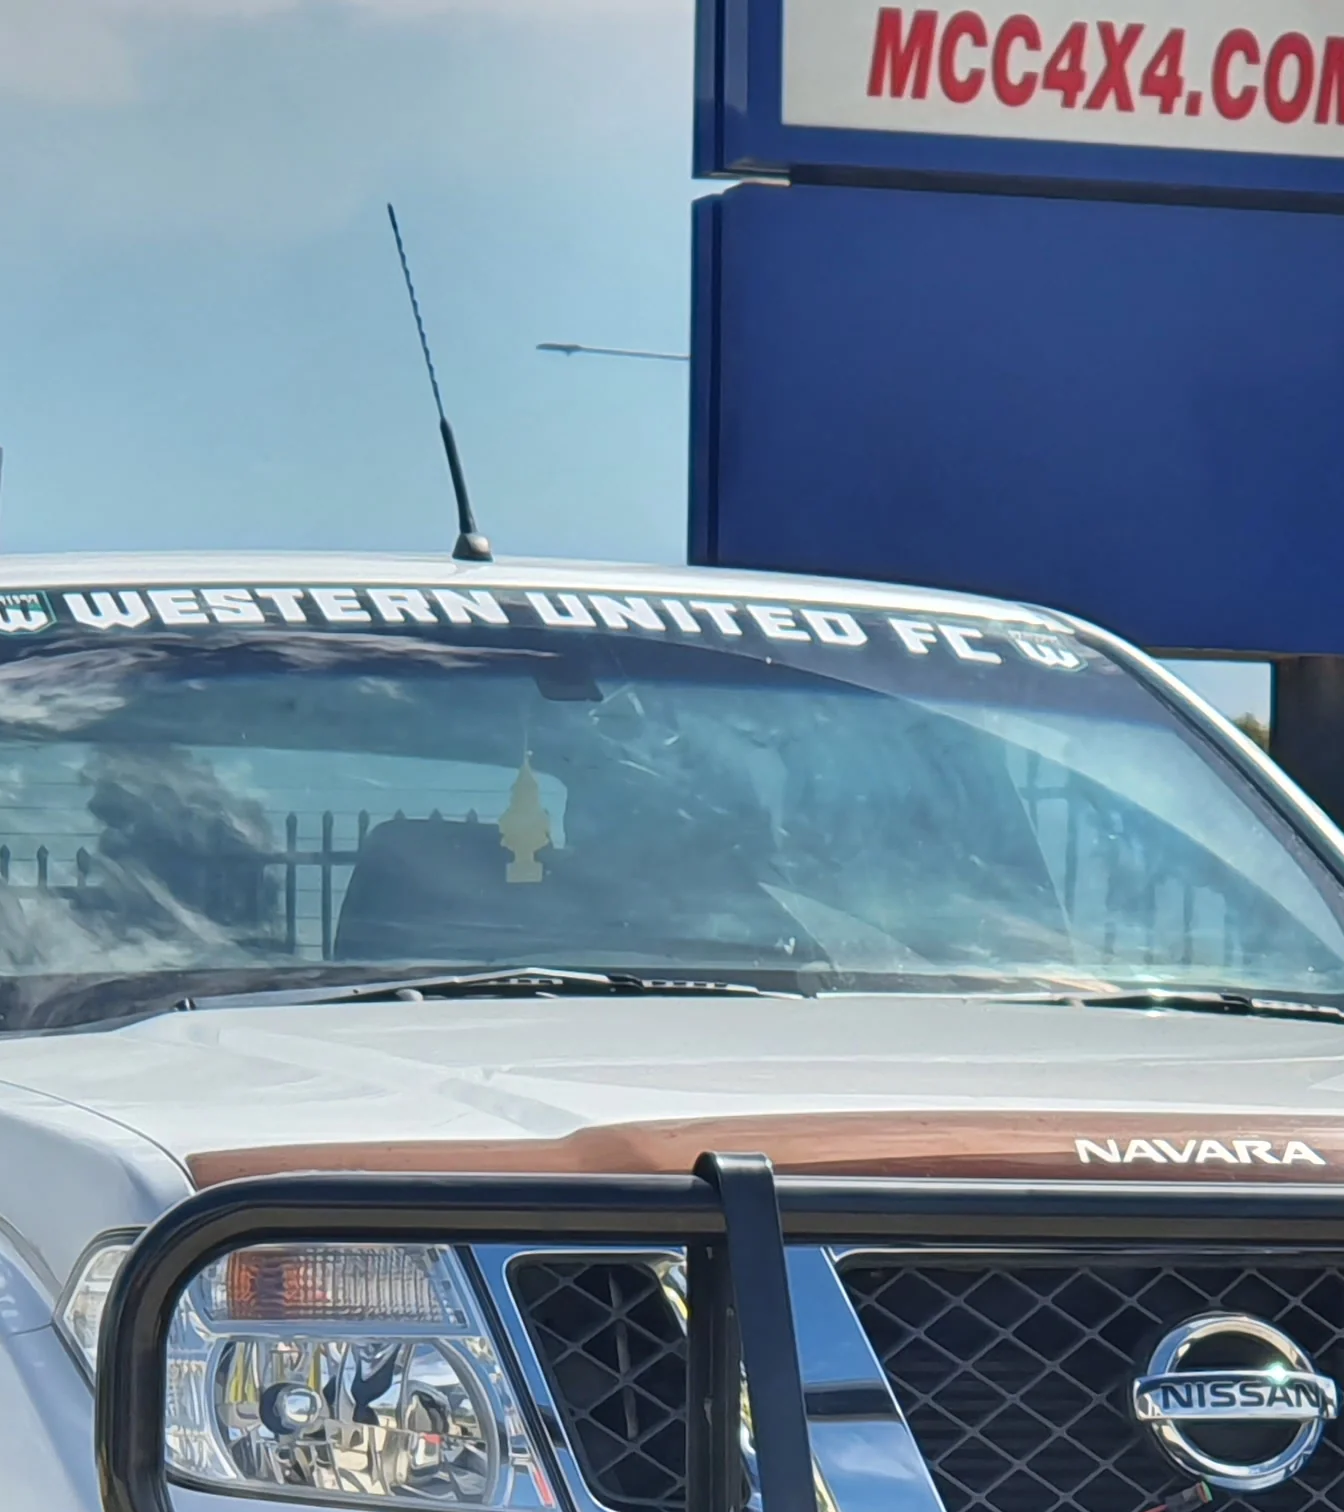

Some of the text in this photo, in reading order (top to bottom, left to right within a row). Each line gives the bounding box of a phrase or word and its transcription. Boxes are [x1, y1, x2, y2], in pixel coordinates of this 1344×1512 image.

[62, 588, 1003, 665] WESTERN UNITED FC
[1074, 1139, 1327, 1165] NAVARA
[1160, 1381, 1322, 1411] NISSAN
